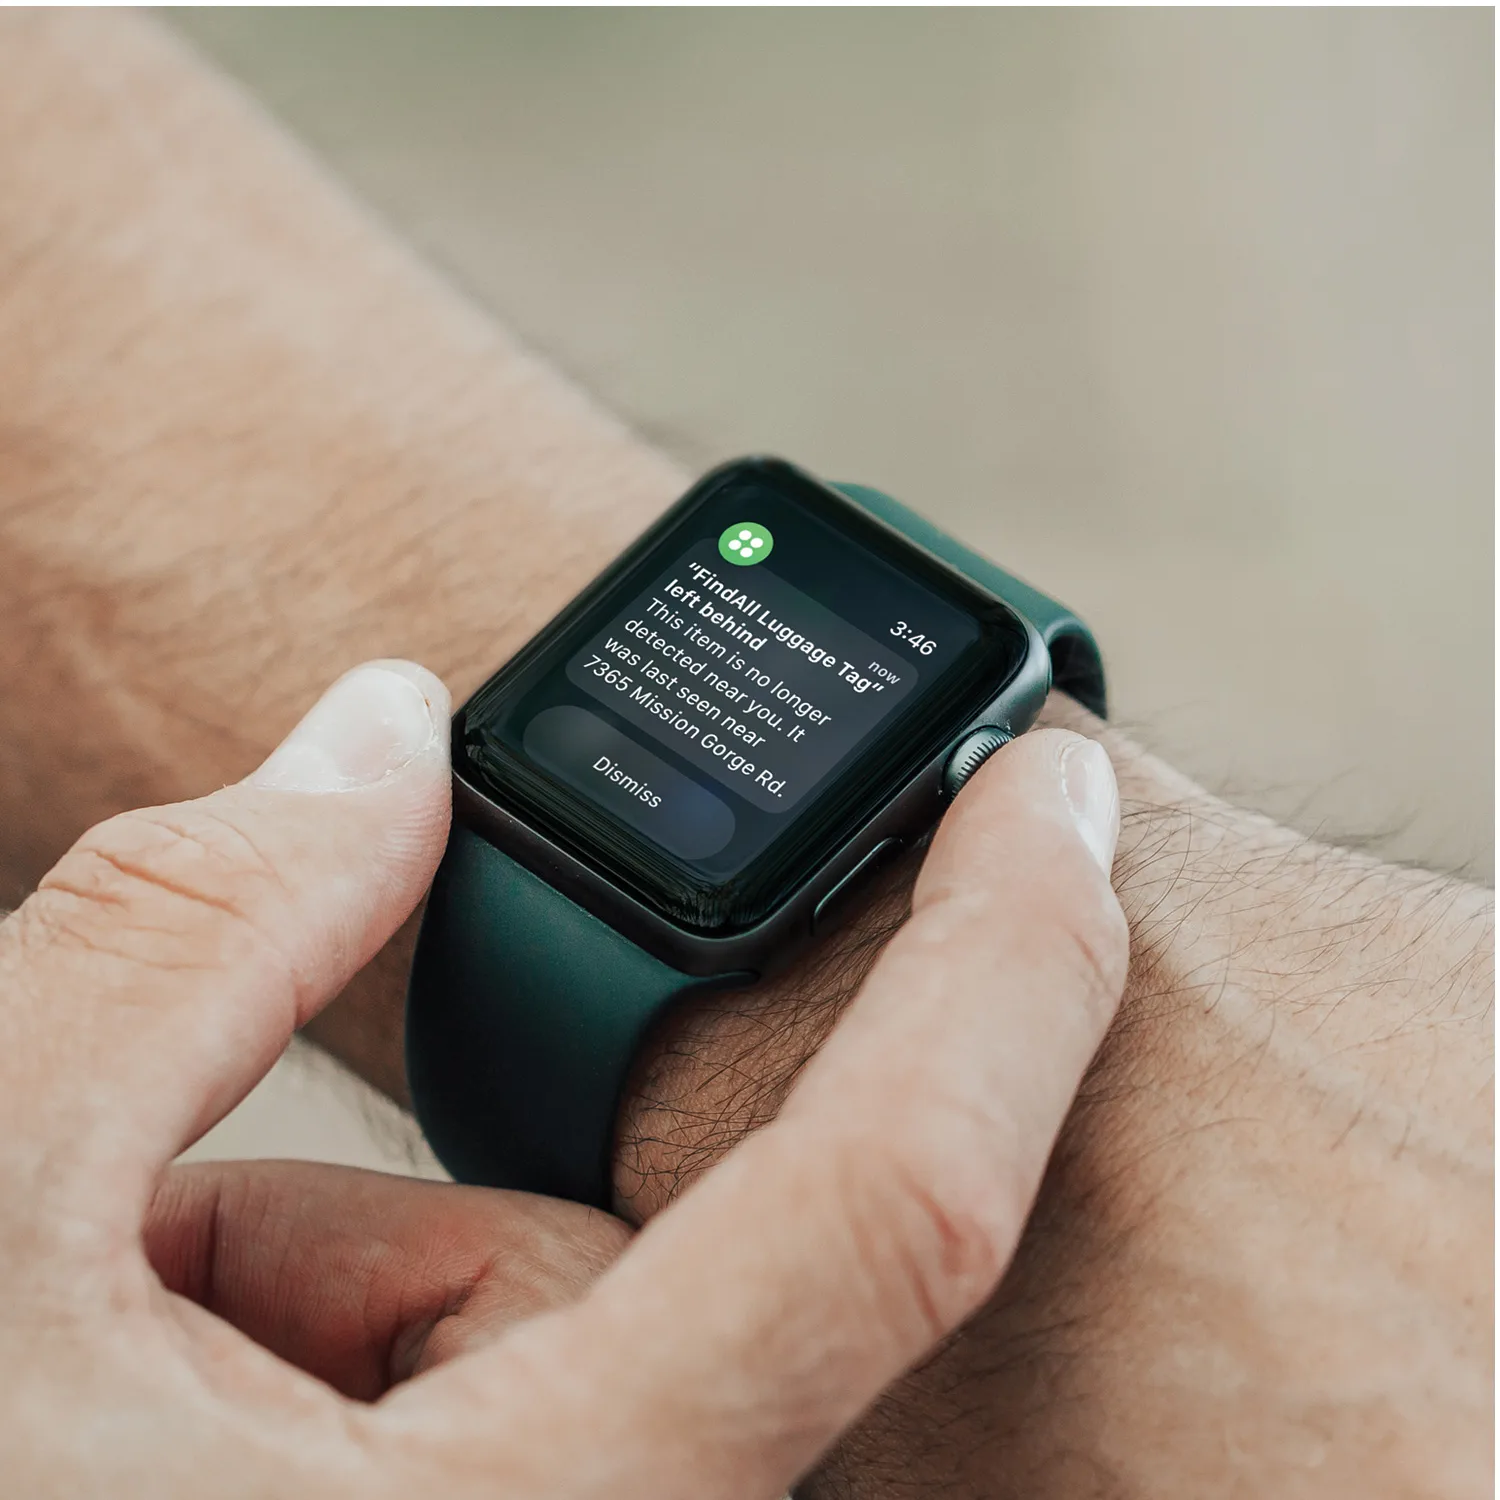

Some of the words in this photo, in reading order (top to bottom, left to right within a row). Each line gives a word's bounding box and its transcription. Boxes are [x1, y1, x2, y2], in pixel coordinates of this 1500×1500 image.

[664, 579, 700, 609] left
[698, 596, 768, 652] behind
[757, 609, 836, 668] Luggage
[890, 621, 938, 656] 3:46
[604, 638, 641, 666] was
[640, 659, 678, 691] last
[676, 684, 720, 720] seen
[721, 714, 766, 749] near
[625, 618, 707, 676] detected
[704, 670, 748, 703] near
[742, 698, 782, 732] you.
[787, 724, 807, 743] It
[646, 598, 684, 630] This
[685, 625, 727, 659] item
[726, 651, 746, 671] is
[745, 664, 771, 687] no
[770, 680, 831, 726] longer
[868, 660, 900, 685] now
[583, 655, 633, 692] 7365
[629, 688, 700, 739] Mission
[700, 733, 756, 776] Gorge
[756, 769, 786, 798] Rd.
[592, 756, 662, 808] Dismiss
